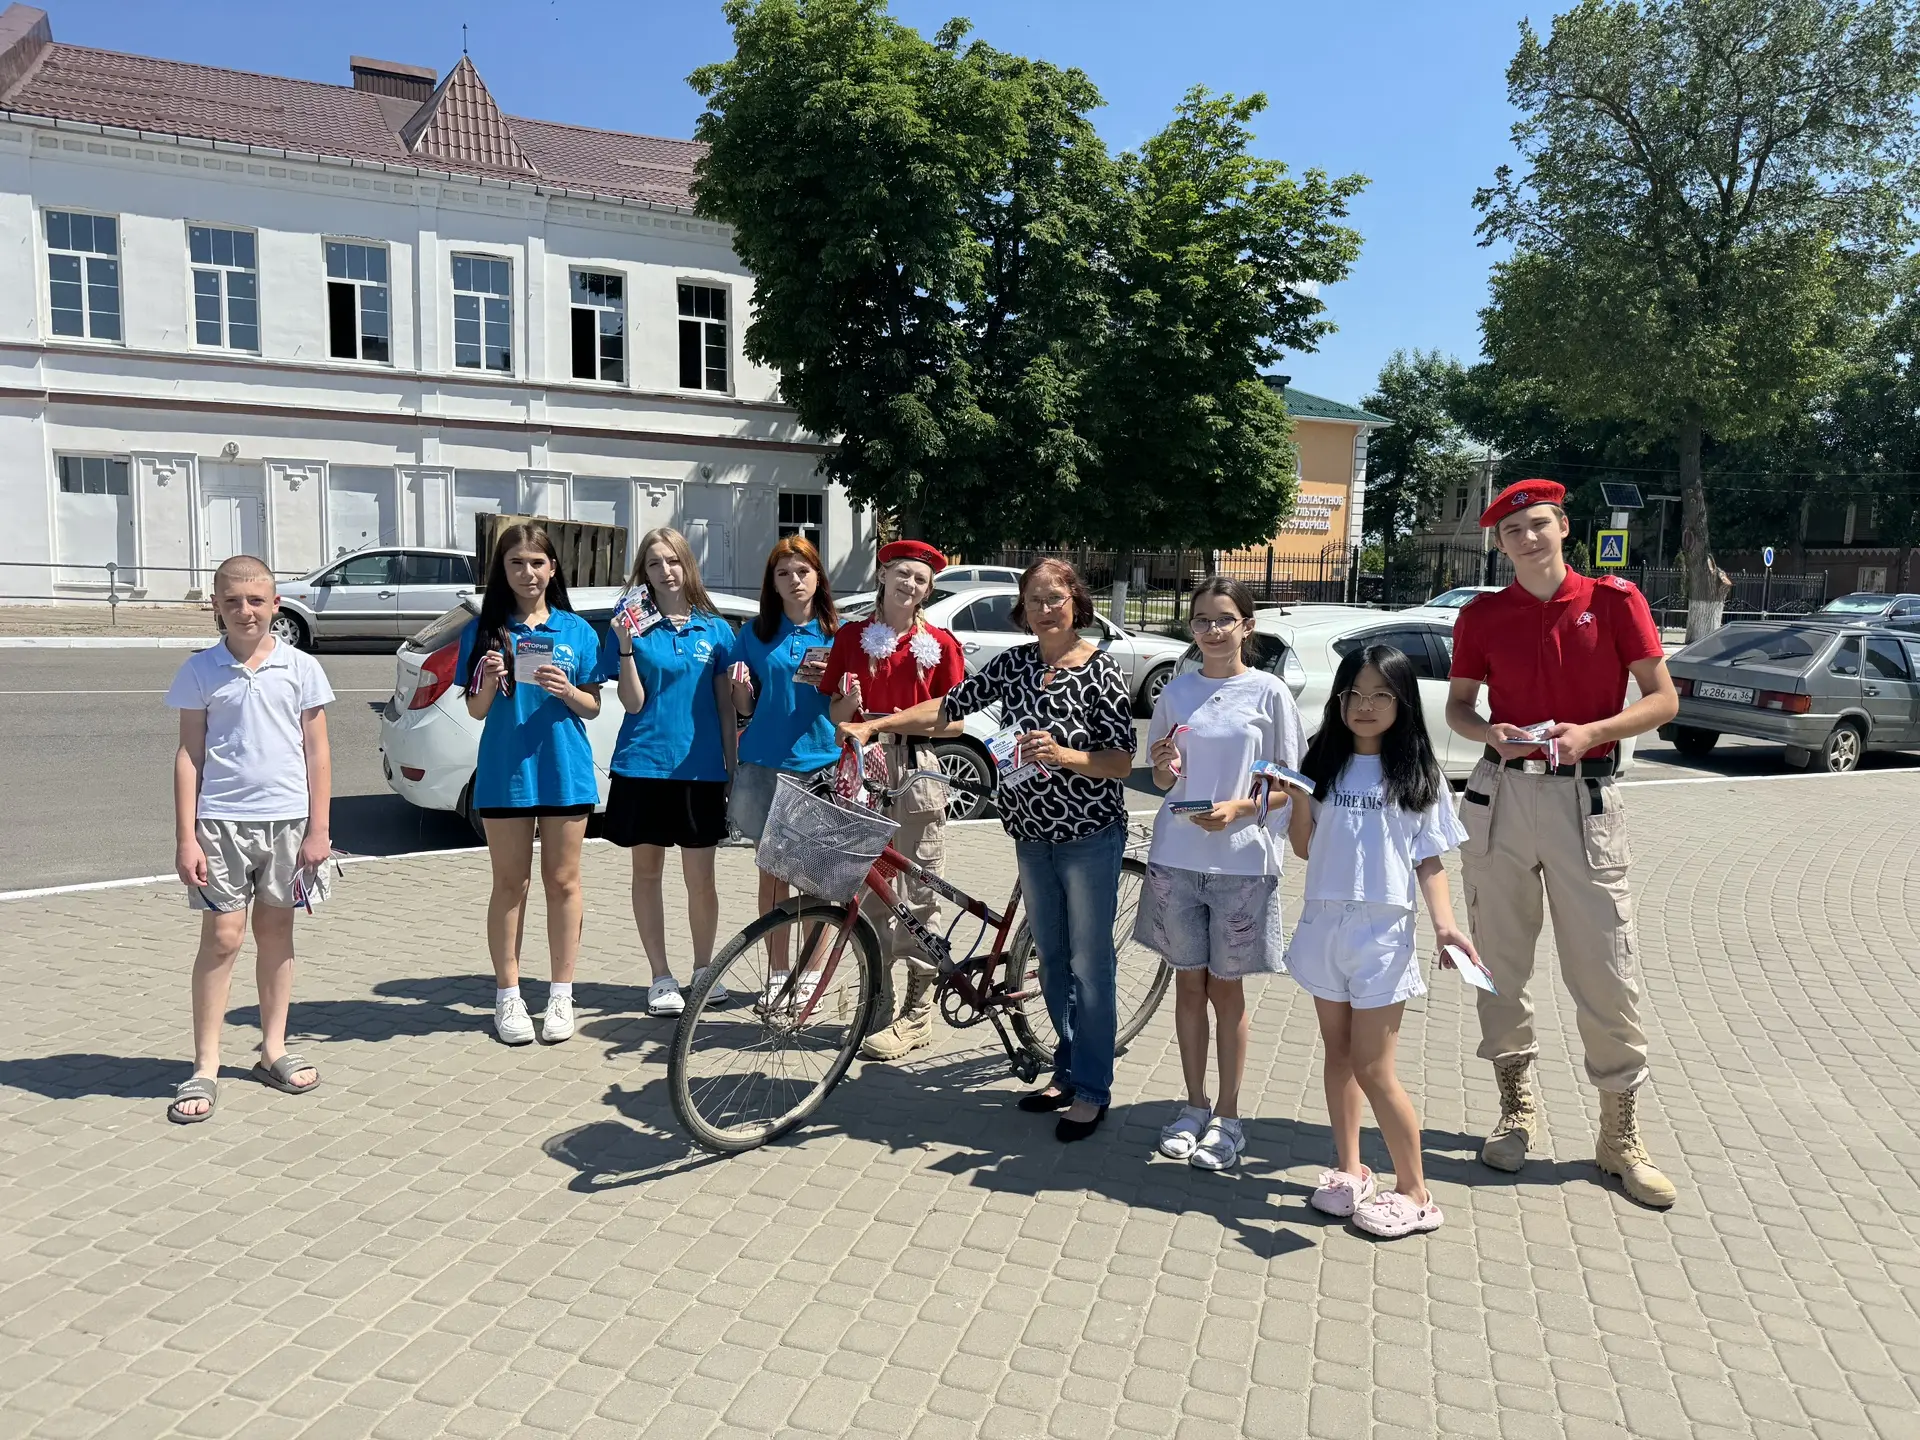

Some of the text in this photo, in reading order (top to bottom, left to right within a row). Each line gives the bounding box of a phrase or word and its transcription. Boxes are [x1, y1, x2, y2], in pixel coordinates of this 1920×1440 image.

[519, 642, 549, 650] ИСТОРИЯ
[1334, 793, 1383, 811] DREAMS
[892, 902, 948, 960] STELS
